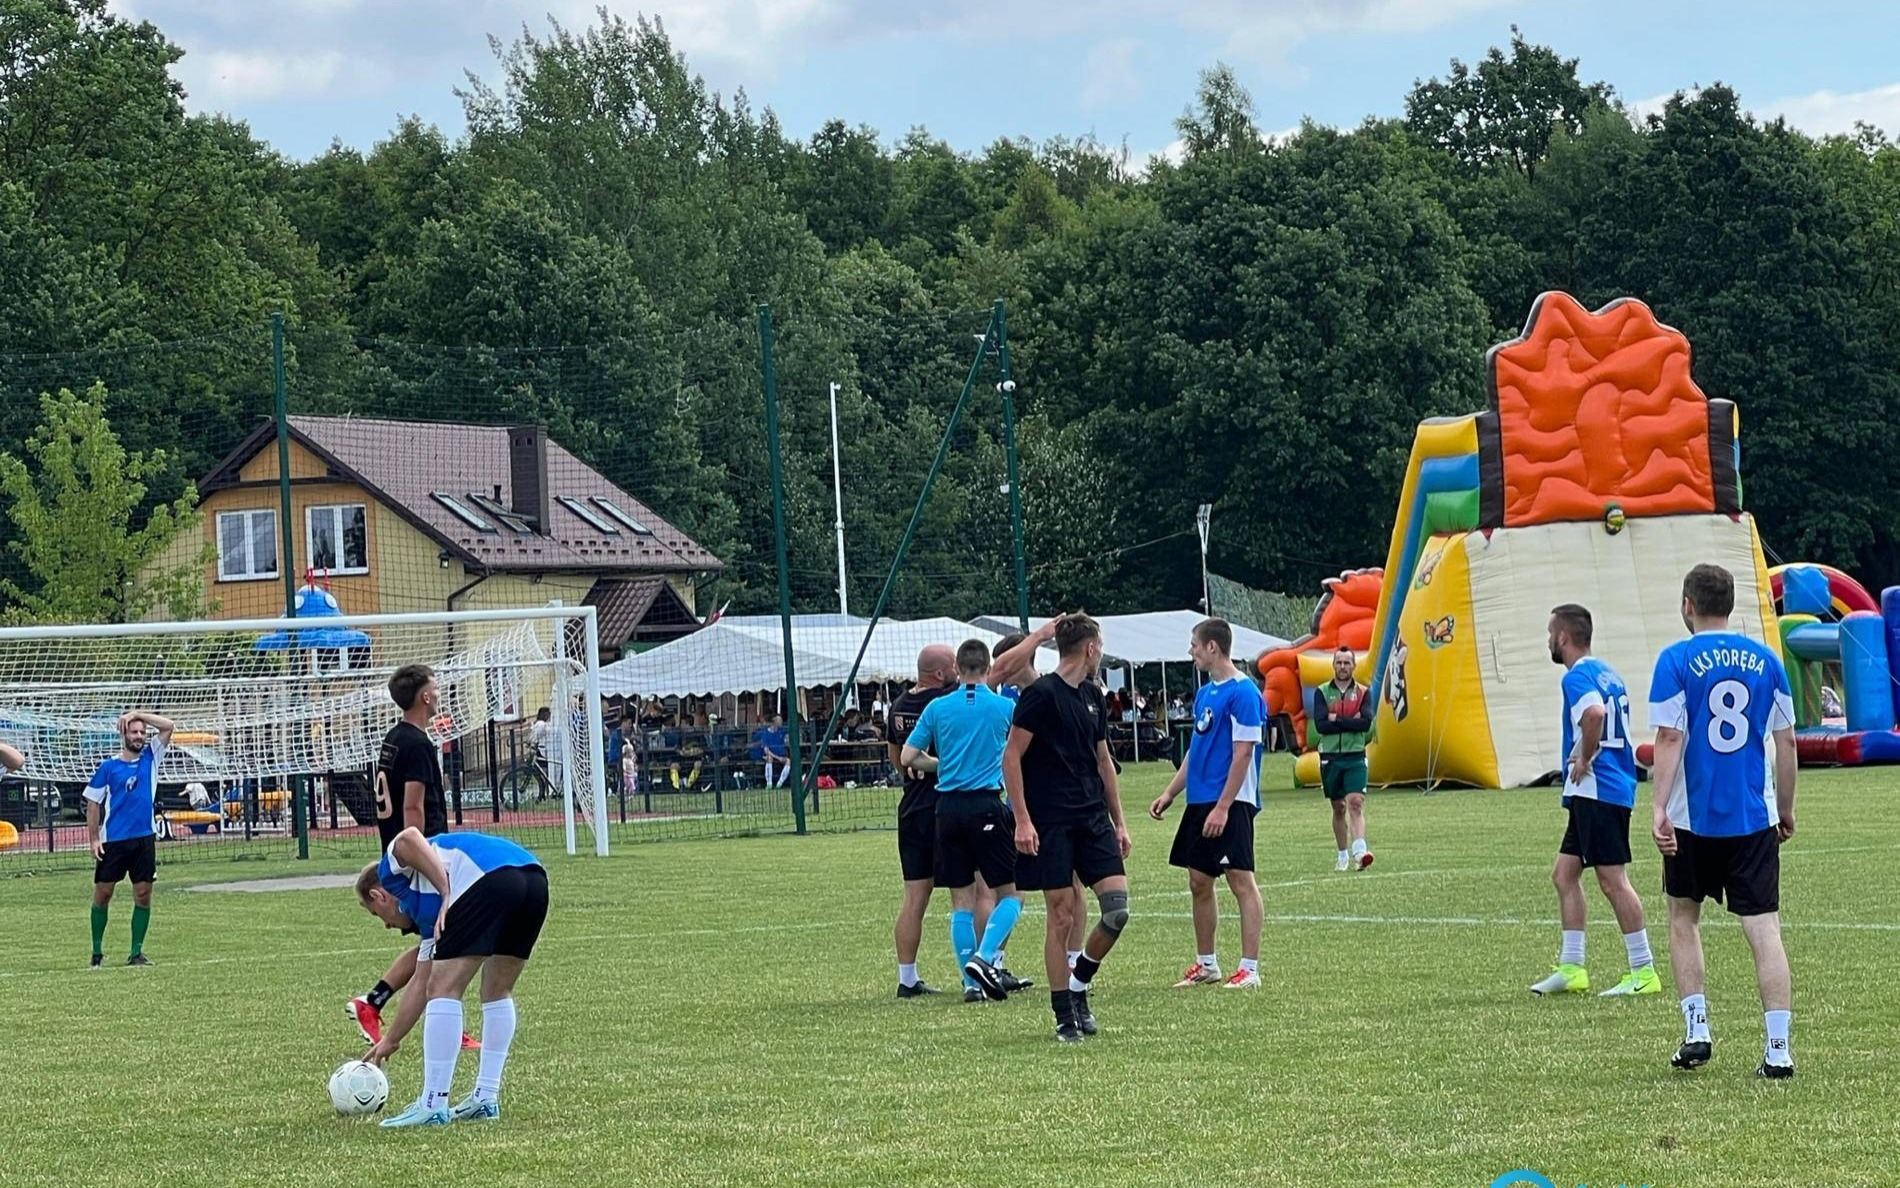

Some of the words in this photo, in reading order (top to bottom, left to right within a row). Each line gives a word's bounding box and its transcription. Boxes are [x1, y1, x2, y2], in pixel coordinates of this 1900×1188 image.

[1688, 650, 1713, 678] LKS
[1712, 648, 1765, 677] PORĘBA
[1707, 679, 1750, 754] 8
